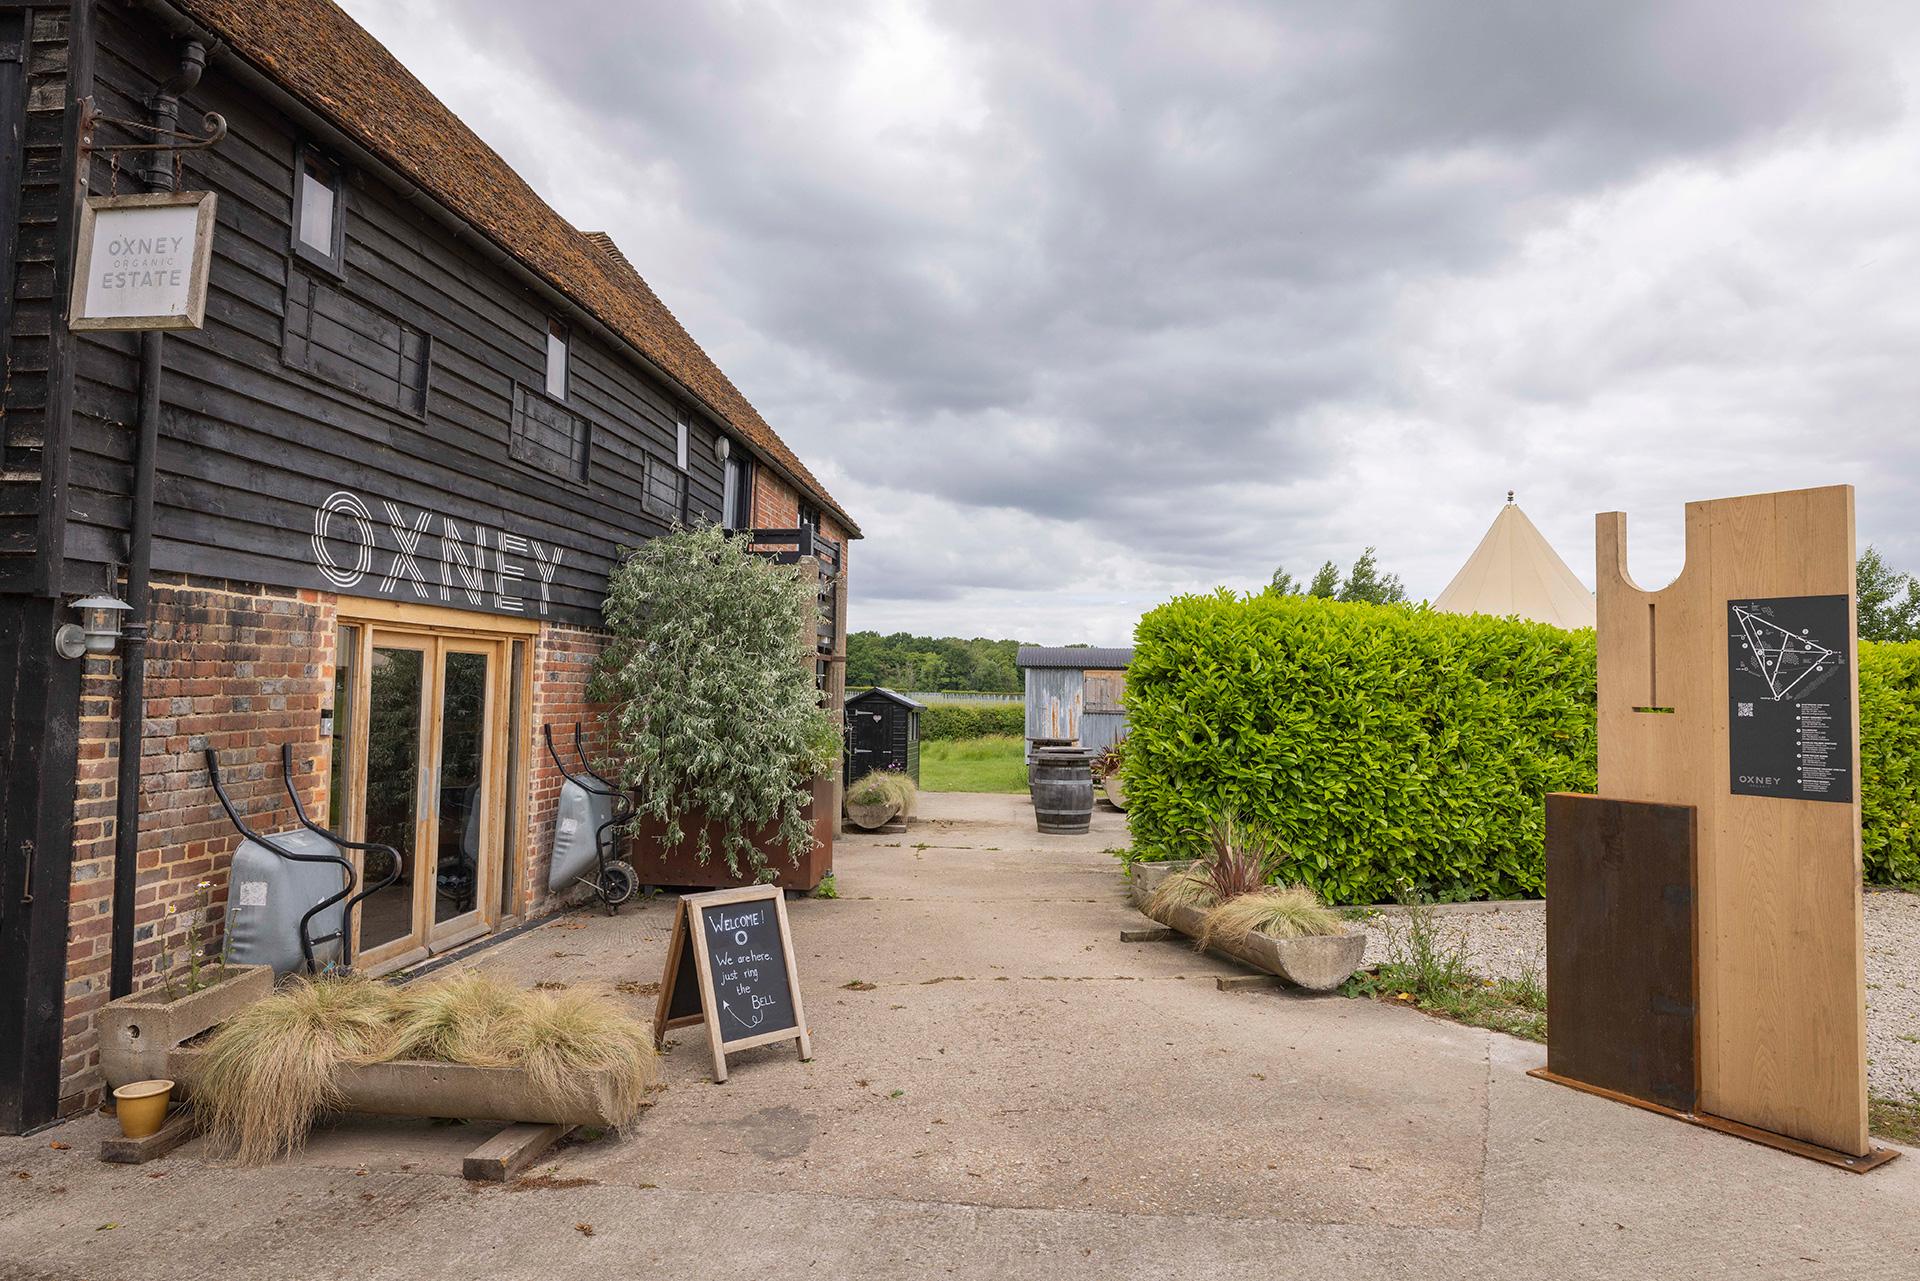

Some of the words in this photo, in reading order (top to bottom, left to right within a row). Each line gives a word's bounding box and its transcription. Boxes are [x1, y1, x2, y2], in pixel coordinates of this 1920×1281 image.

[108, 236, 183, 256] OXNEY
[113, 257, 174, 268] ORGANIC
[102, 270, 182, 289] ESTATE
[311, 491, 563, 615] OXNEY
[1739, 775, 1781, 785] OXNEY
[715, 951, 733, 966] We
[737, 955, 750, 964] are
[721, 971, 738, 986] just
[743, 967, 759, 982] ring
[736, 983, 751, 996] the
[751, 994, 776, 1010] BELL
